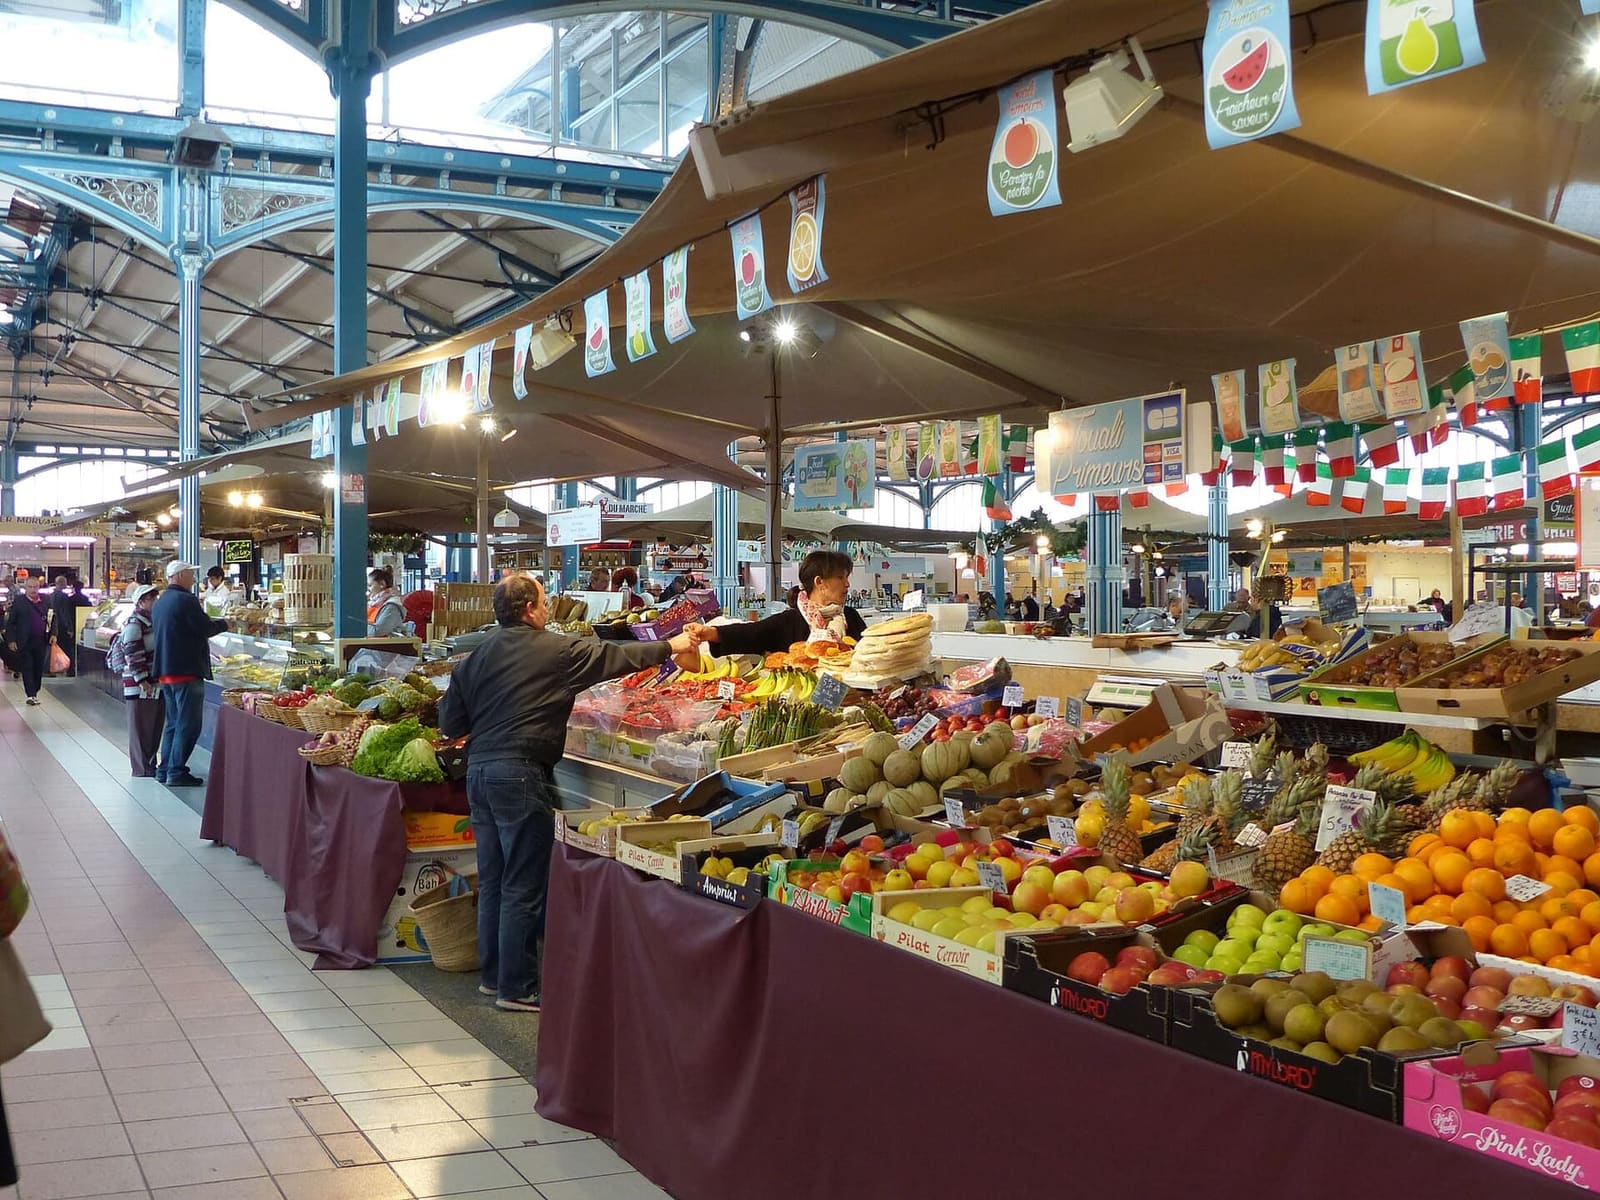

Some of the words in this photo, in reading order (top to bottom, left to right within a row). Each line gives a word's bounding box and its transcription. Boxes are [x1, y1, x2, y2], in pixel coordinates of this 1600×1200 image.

[1232, 111, 1269, 130] saveur
[1054, 459, 1145, 495] Primeurs
[628, 849, 645, 863] Pilat
[418, 878, 437, 889] Bah
[896, 931, 930, 953] Pilat
[936, 945, 970, 965] Terroir
[1433, 1111, 1454, 1125] Pink
[1468, 1126, 1527, 1160] Pink
[1527, 1141, 1589, 1190] Lady
